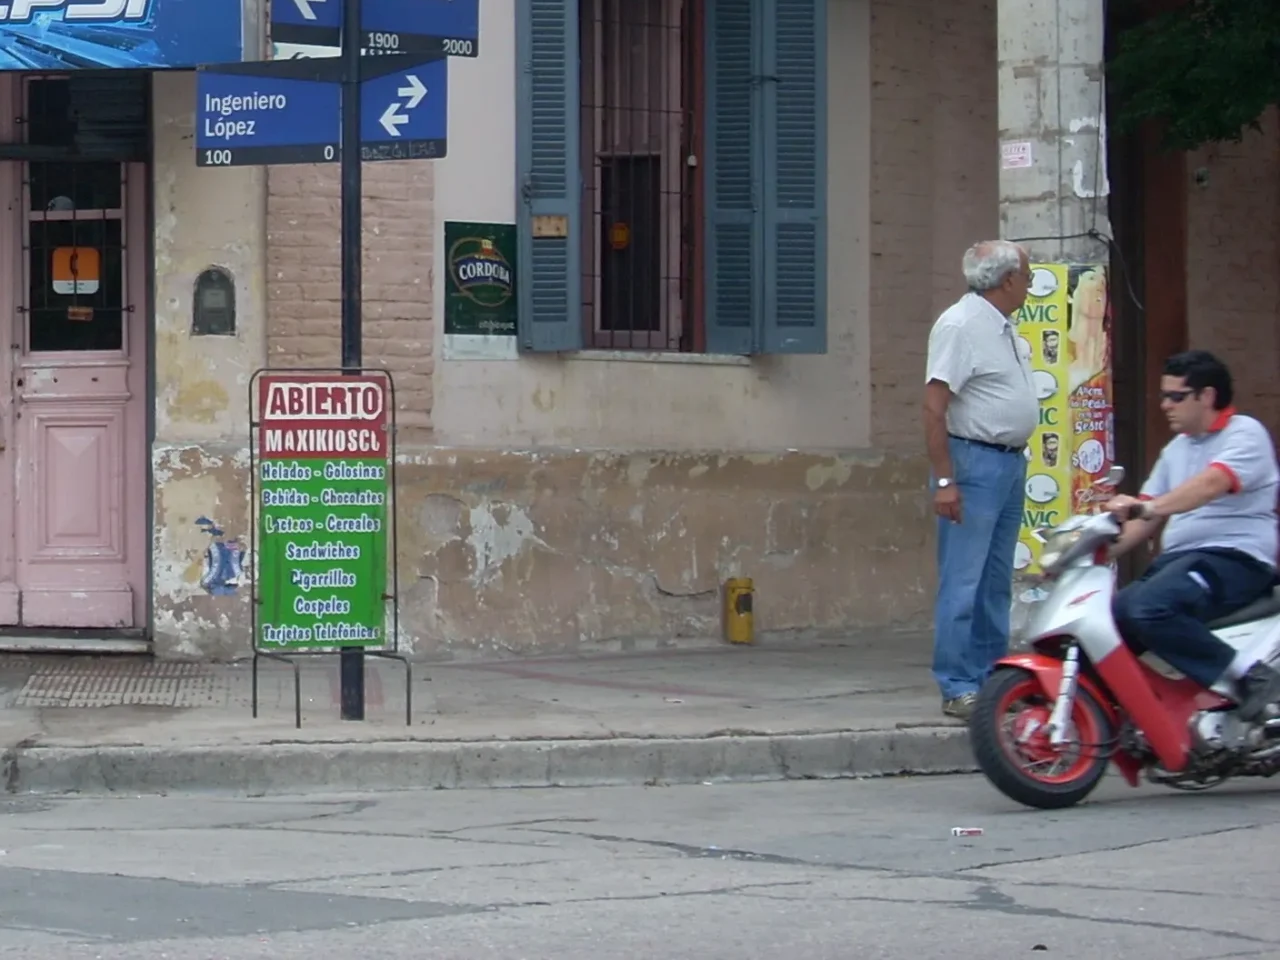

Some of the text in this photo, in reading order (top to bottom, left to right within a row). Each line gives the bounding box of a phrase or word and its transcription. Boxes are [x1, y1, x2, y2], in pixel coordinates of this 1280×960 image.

[368, 32, 399, 49] 1900
[442, 39, 473, 55] 2000
[205, 93, 286, 115] Ingeniero
[205, 118, 255, 140] López
[205, 149, 232, 165] 100
[323, 145, 334, 161] 0
[267, 384, 381, 418] ABIERTO
[261, 461, 312, 480] Helados
[324, 461, 384, 479] Golosinas
[262, 488, 309, 506] Bebidas
[322, 488, 383, 506] Chocolates
[326, 514, 381, 532] Cereales
[286, 541, 360, 560] Sandwiches
[291, 568, 356, 591] Cigarrillos
[294, 595, 350, 619] Cospeles
[262, 623, 312, 645] Tarjetas
